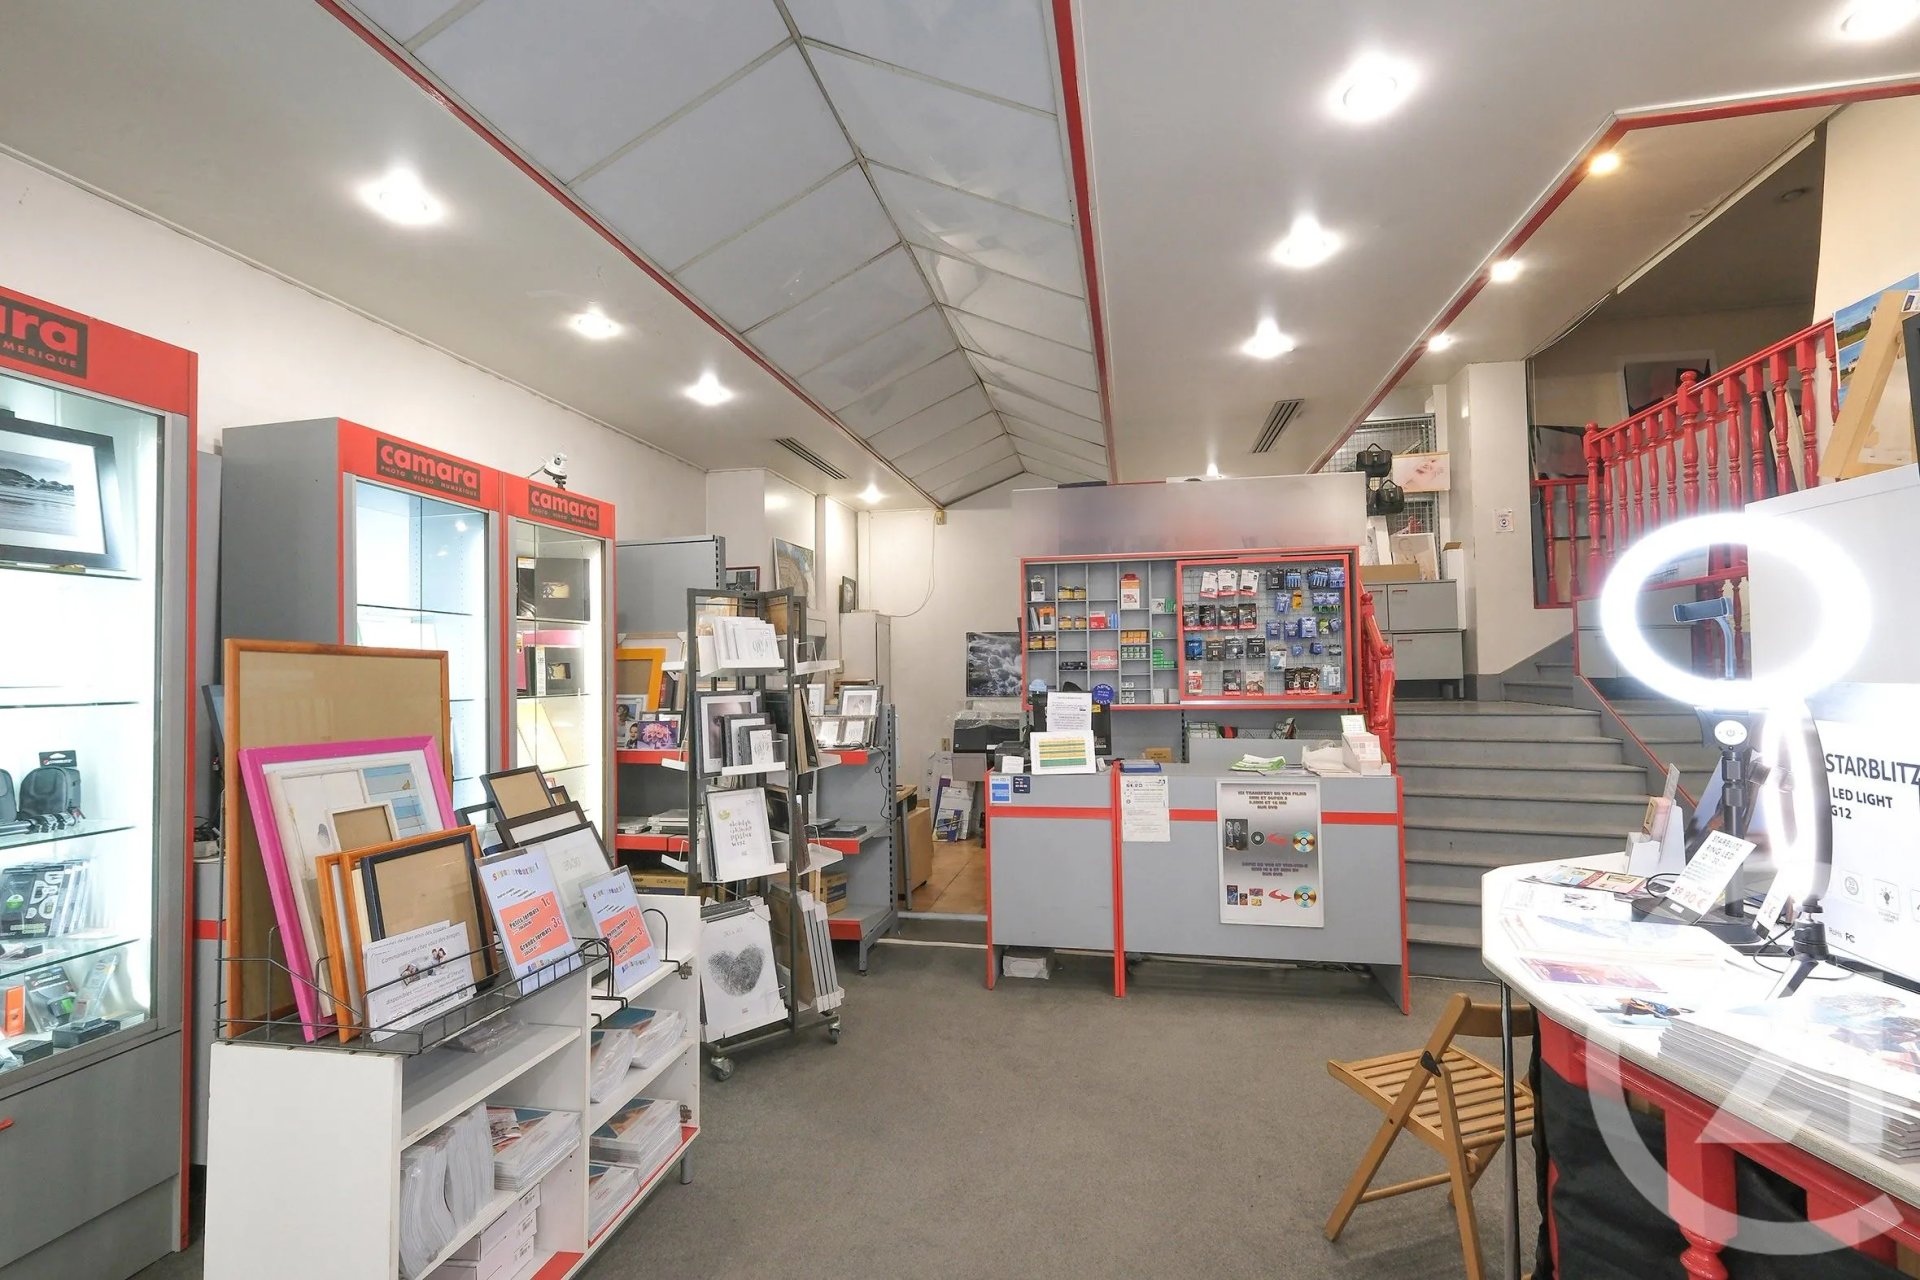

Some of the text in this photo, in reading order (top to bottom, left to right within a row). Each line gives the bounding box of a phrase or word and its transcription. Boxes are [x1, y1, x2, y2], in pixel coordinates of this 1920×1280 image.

[0, 304, 78, 356] ra
[380, 445, 478, 489] camara
[380, 465, 406, 478] PHOTO
[413, 475, 435, 486] VIDEO
[531, 490, 597, 521] camara
[1832, 787, 1893, 809] LED LIGHT
